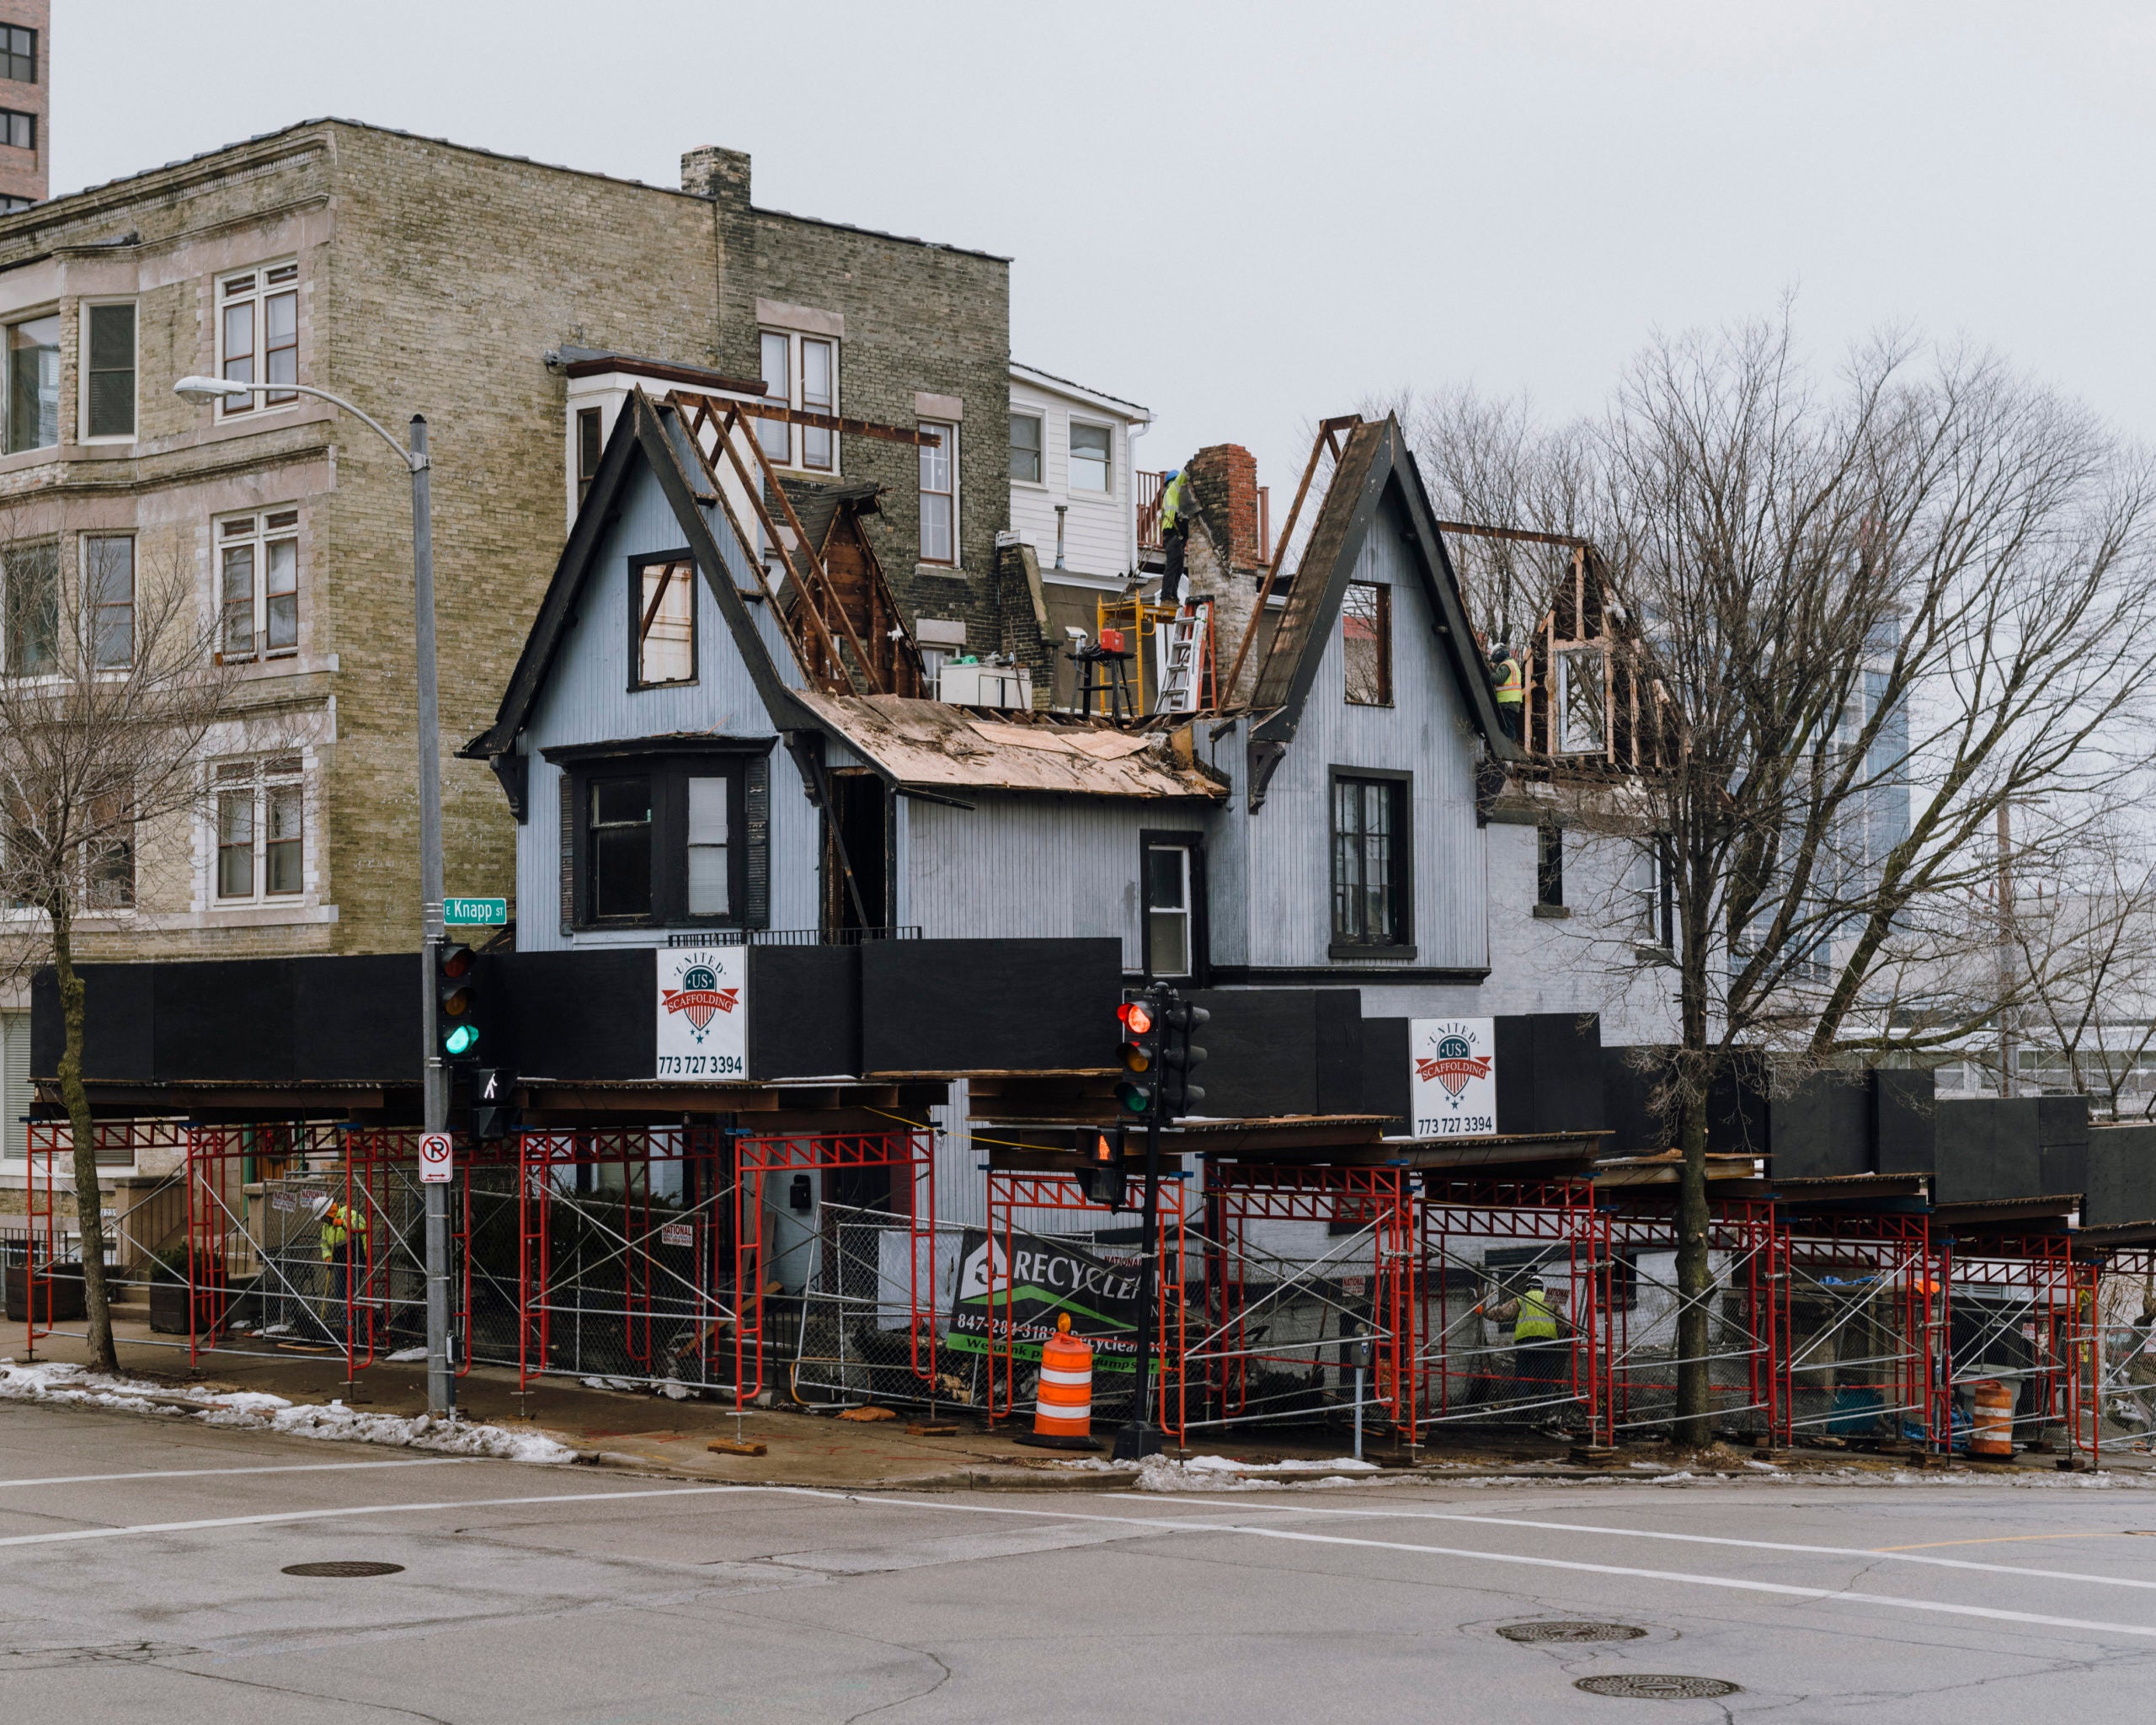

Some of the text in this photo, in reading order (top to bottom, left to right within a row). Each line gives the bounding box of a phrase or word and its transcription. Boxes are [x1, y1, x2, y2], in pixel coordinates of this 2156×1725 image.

[446, 900, 504, 921] E Knapp ST
[675, 952, 723, 975] UNITED
[691, 974, 708, 988] US
[668, 993, 733, 1012] SCAFFOLDING
[1428, 1022, 1477, 1044] UNITED
[1446, 1044, 1462, 1057] US
[659, 1055, 743, 1074] 773 727 3394
[1422, 1061, 1486, 1080] SCAFFOLDING
[1418, 1116, 1492, 1135] 773 727 3394
[663, 1225, 691, 1236] NATIONAL
[967, 1338, 989, 1349] We
